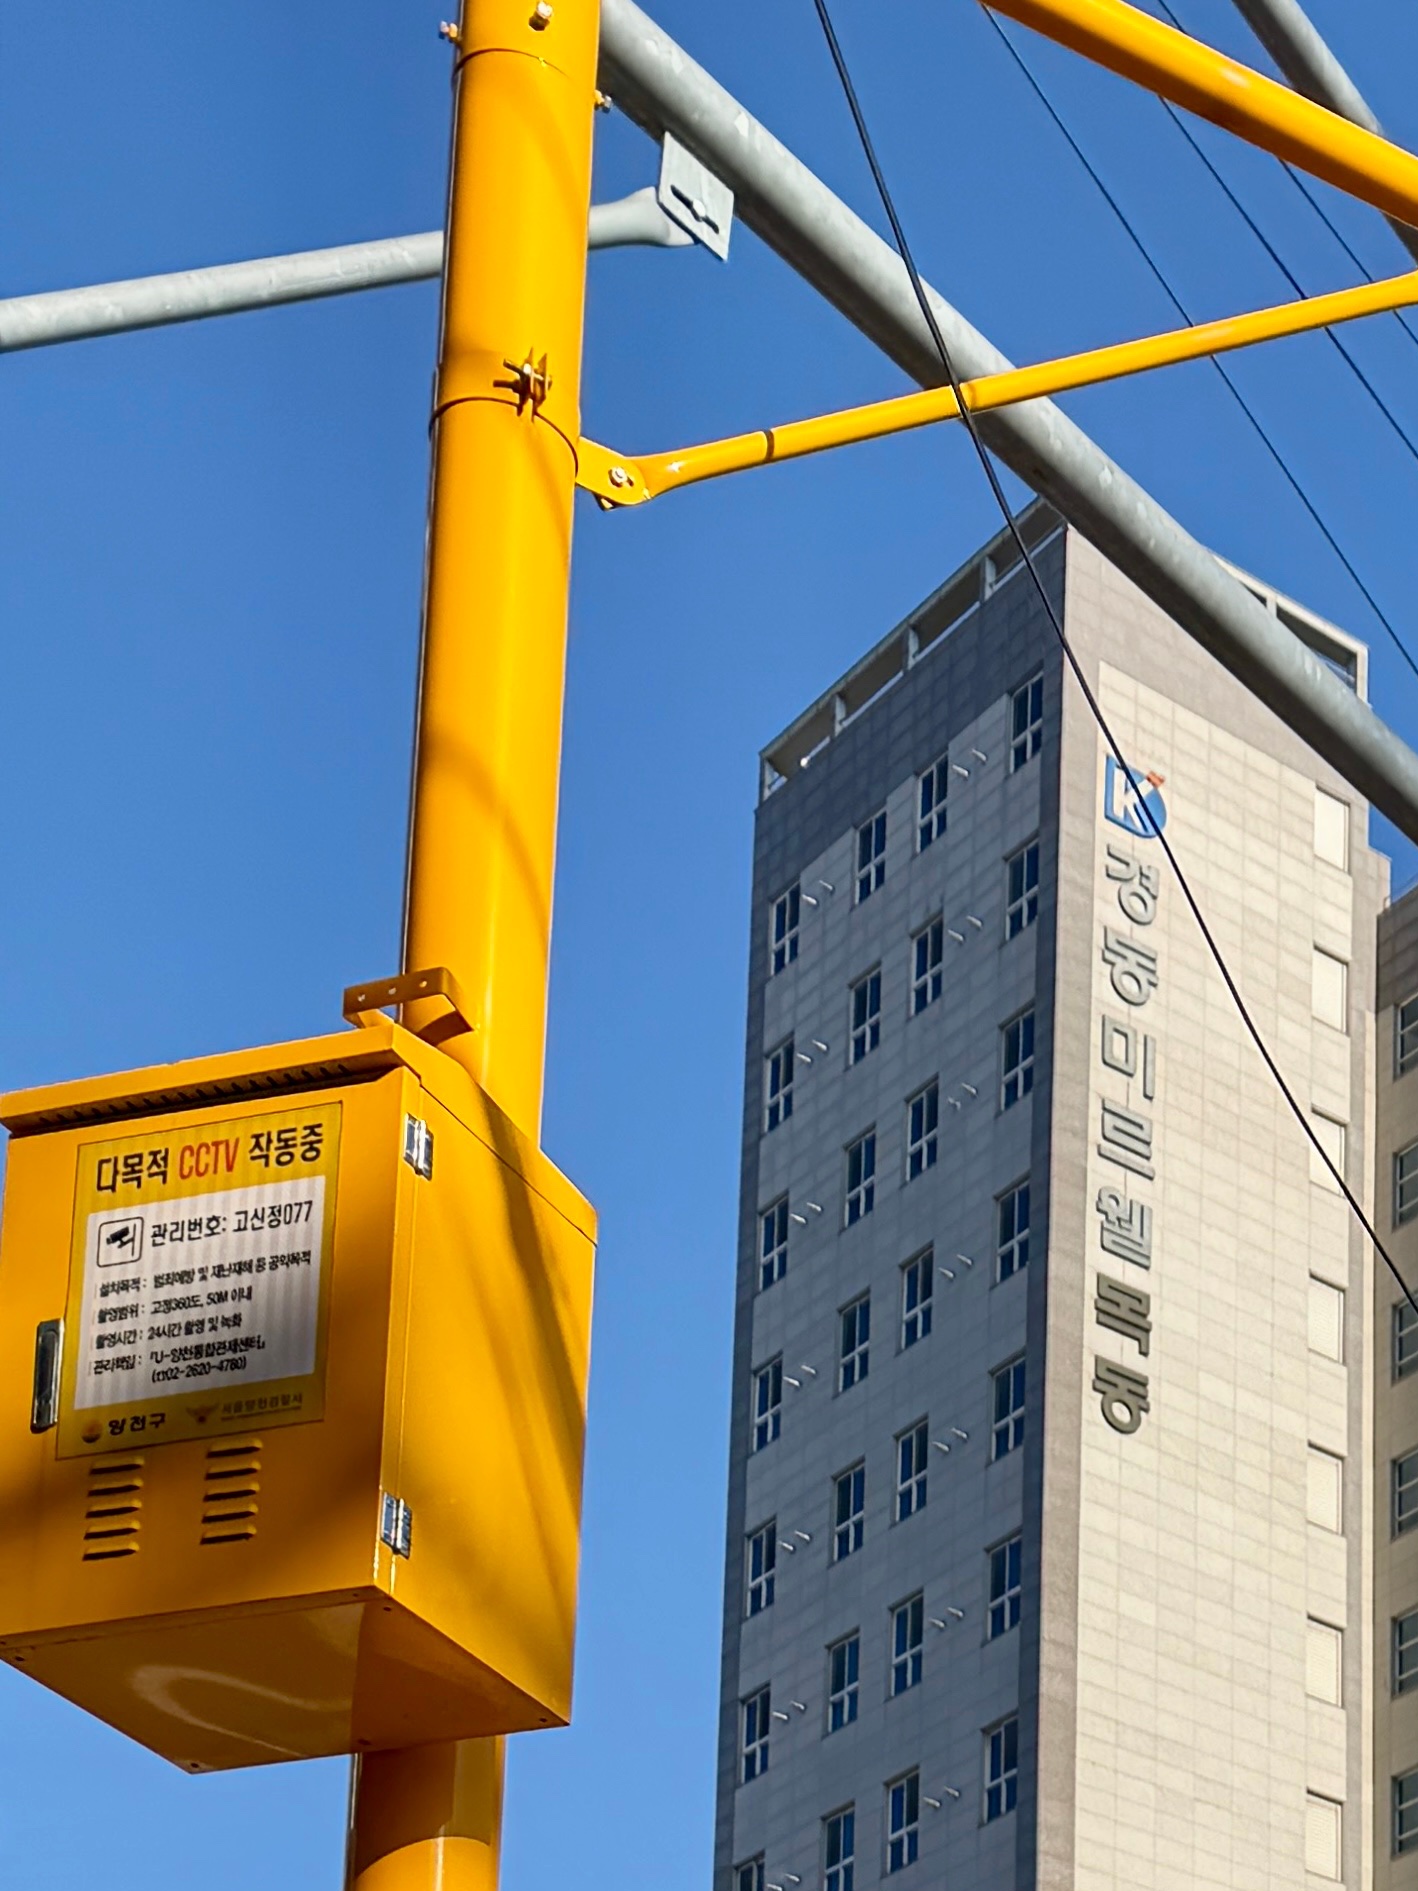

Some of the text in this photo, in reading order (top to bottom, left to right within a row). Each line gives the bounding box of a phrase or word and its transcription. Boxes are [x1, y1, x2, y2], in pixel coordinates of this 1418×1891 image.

[96, 1123, 324, 1194] 다목적 CCTV 작동중
[232, 1200, 314, 1234] 고신정077
